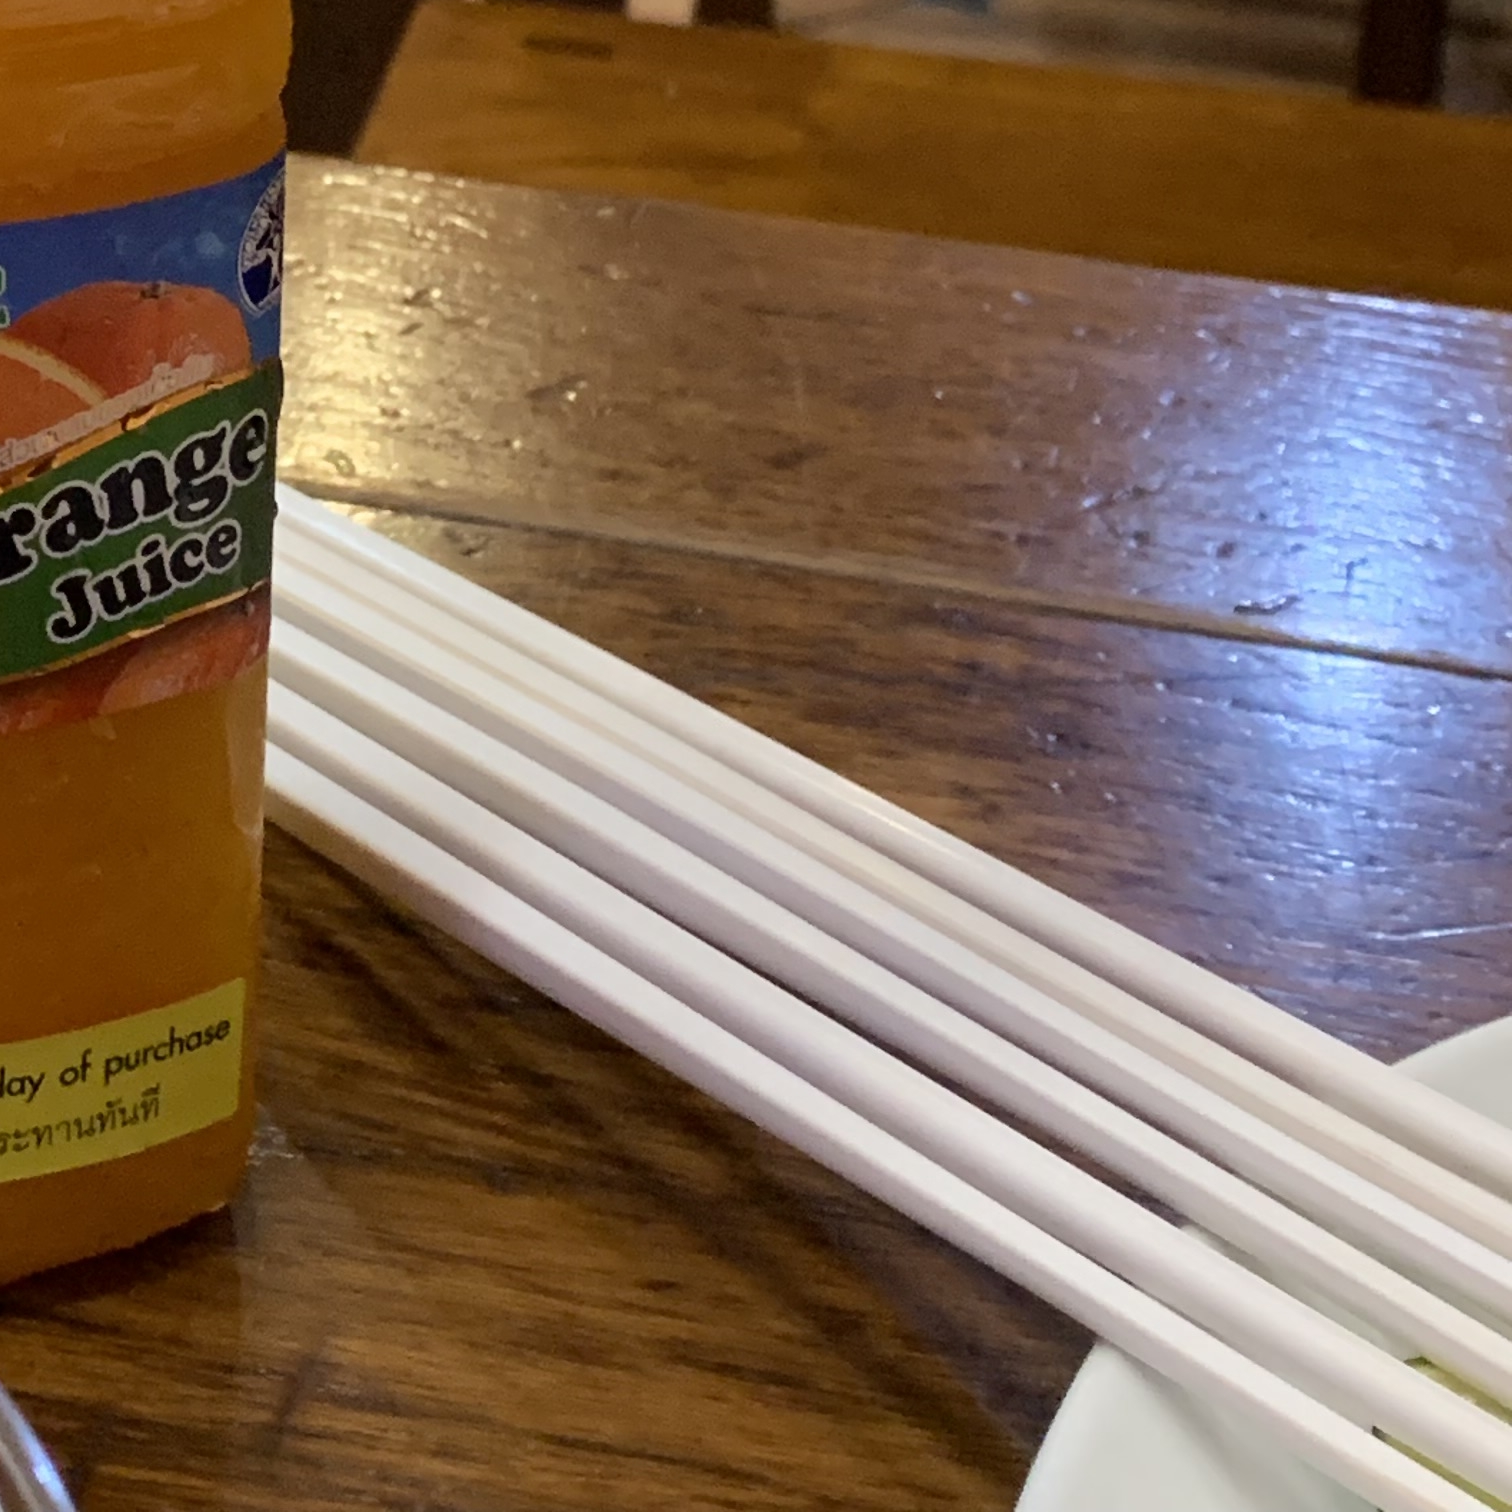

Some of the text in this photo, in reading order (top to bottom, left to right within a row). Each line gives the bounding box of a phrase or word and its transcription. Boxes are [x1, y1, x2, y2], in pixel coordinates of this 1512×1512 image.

[47, 519, 241, 644] Juice
[58, 1048, 93, 1087] of
[103, 1017, 232, 1085] purchase
